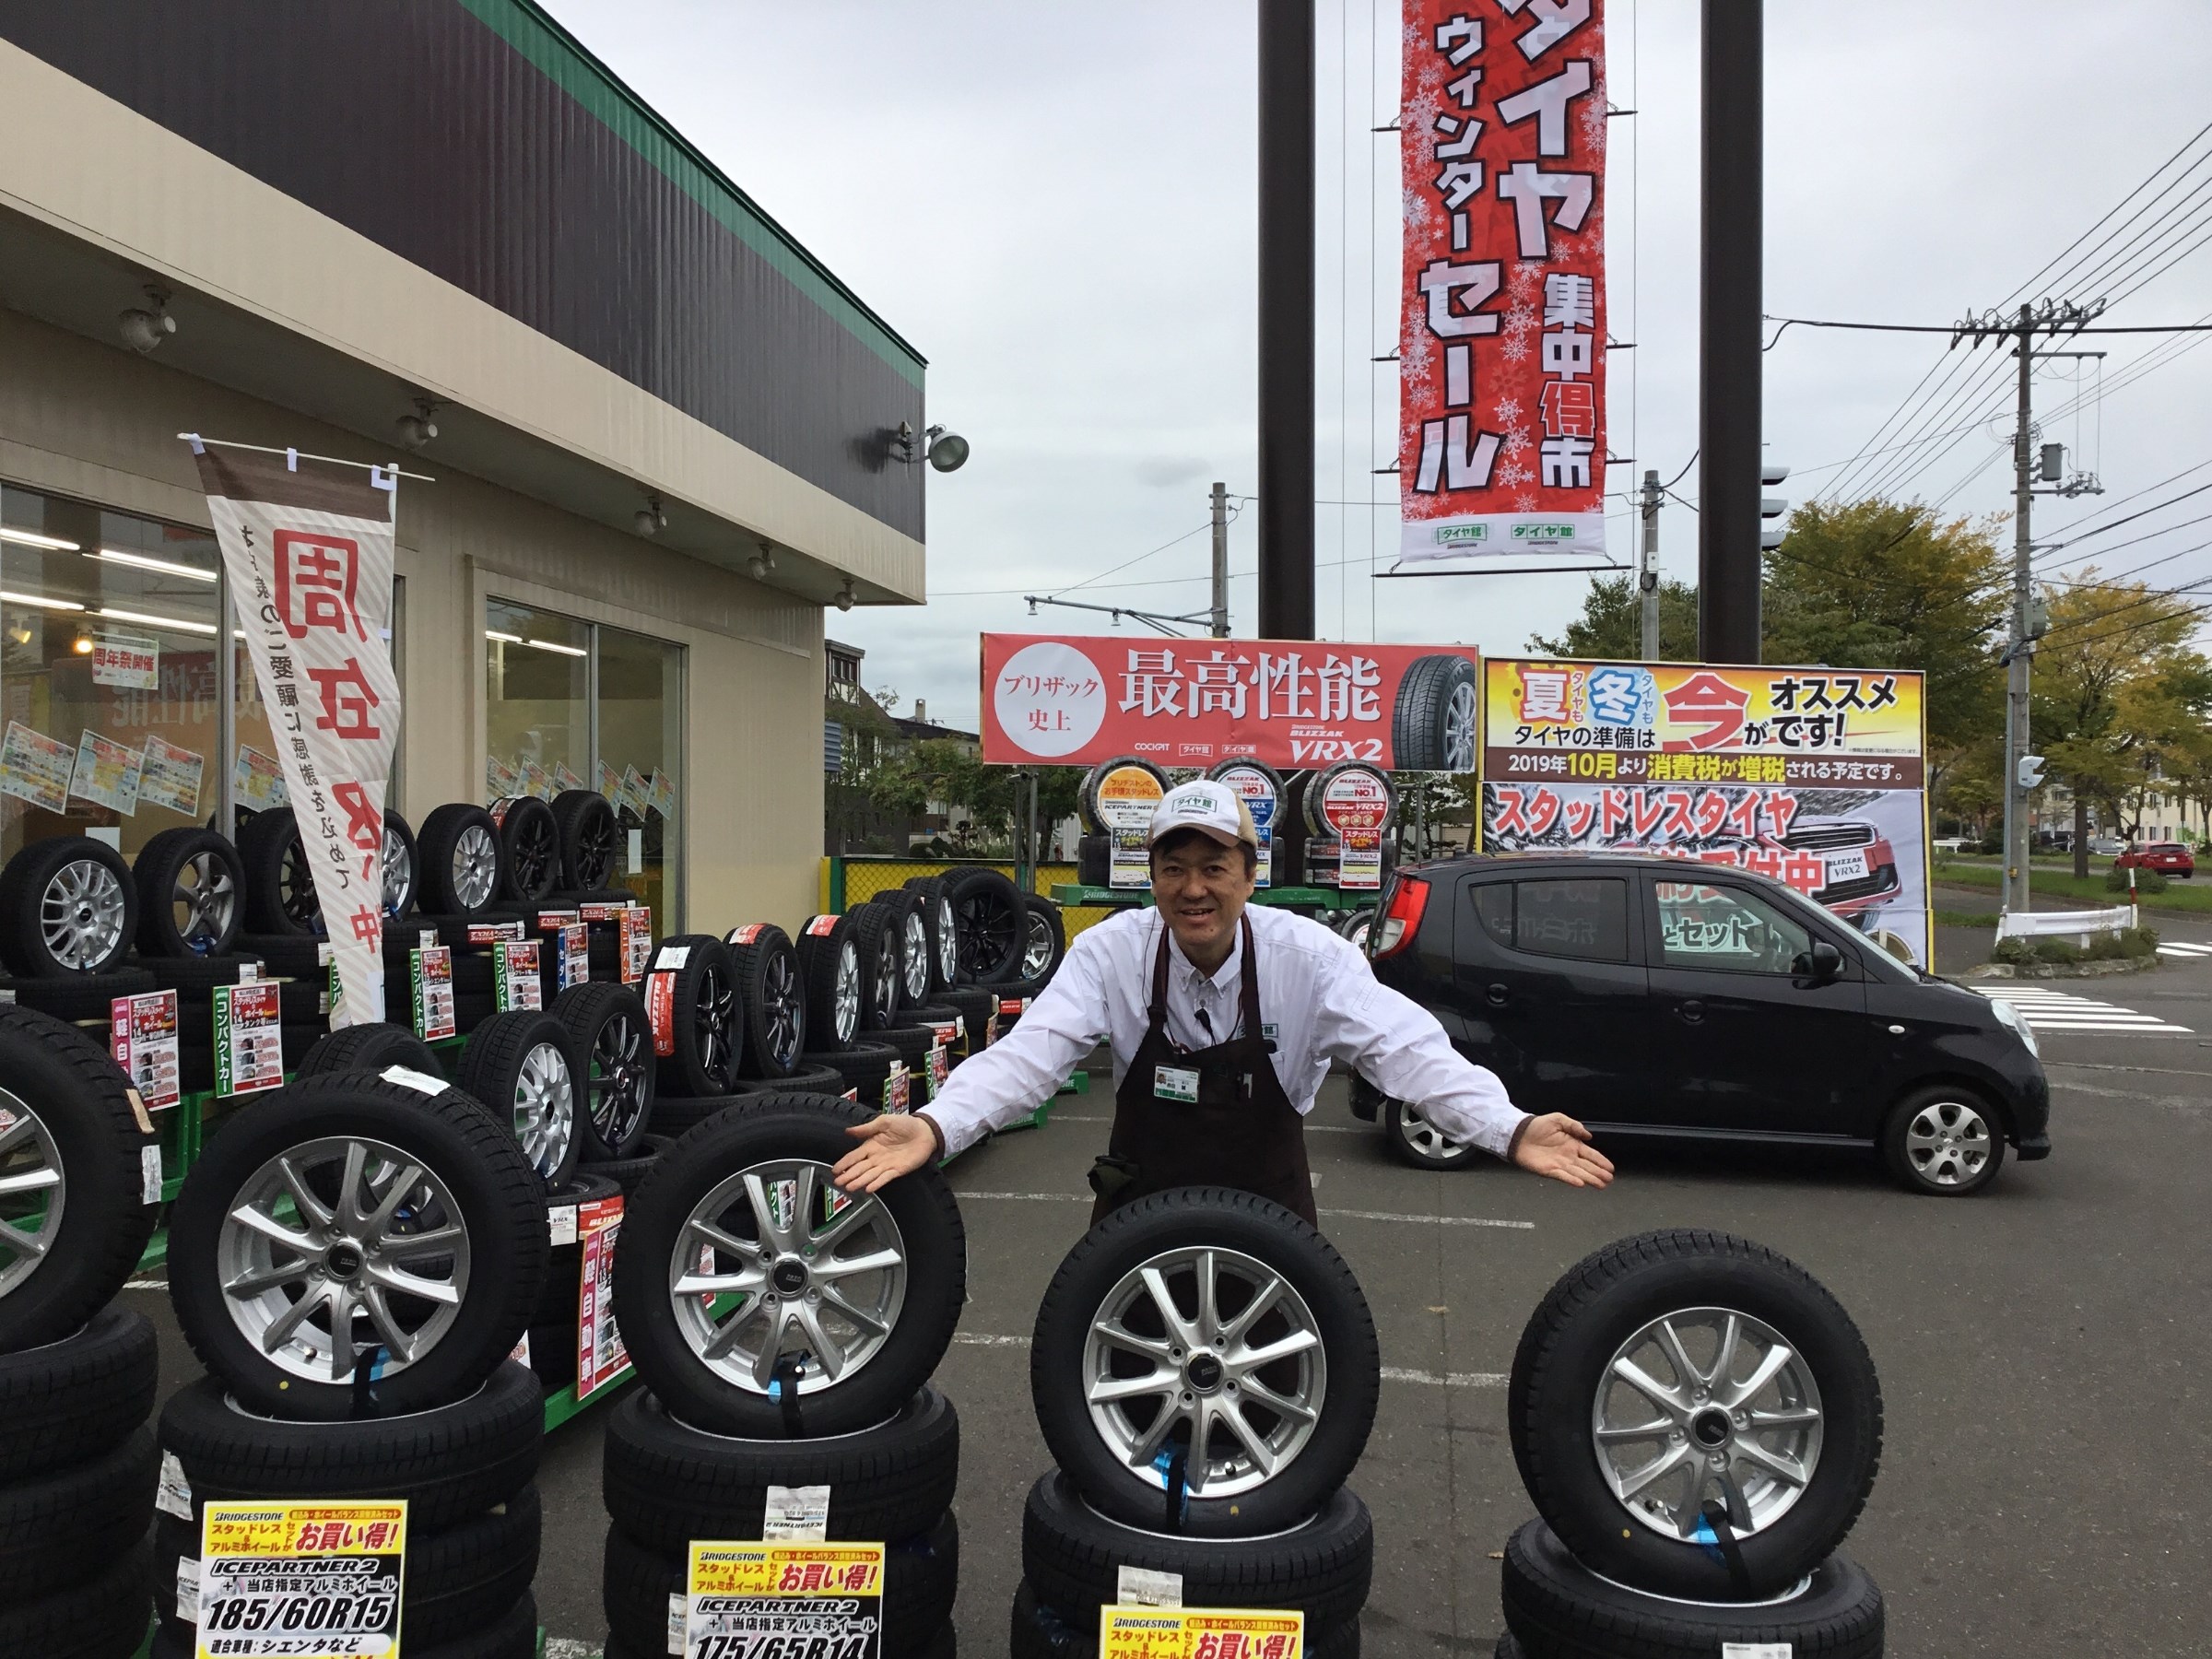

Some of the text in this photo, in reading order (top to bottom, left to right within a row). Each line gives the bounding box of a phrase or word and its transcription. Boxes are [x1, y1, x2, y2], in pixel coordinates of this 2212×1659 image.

[1442, 526, 1482, 539] タイヤ館
[1513, 526, 1573, 537] タイヤ館
[1004, 674, 1099, 698] ブリザック
[1117, 646, 1383, 723] 最高性能
[1520, 668, 1571, 724] 夏
[1572, 672, 1583, 722] タイヤも
[1589, 670, 1641, 725] 冬
[1641, 675, 1653, 724] タイヤも
[1771, 677, 1897, 710] オススメ
[1663, 674, 1749, 750] 今
[1029, 709, 1071, 732] 史上
[1514, 726, 1655, 748] タイヤの準備は
[1135, 743, 1170, 751] COCKPIT
[1182, 746, 1209, 754] タイヤ館
[1288, 739, 1383, 763] VRX2
[1355, 786, 1376, 797] NO.1
[1177, 797, 1212, 808] タイヤ館
[1495, 788, 1797, 838] スタッドレスタイヤ
[1828, 856, 1863, 867] BLIZZAK
[1834, 865, 1862, 877] VRX2
[621, 922, 629, 977] ミニバン
[412, 961, 424, 1038] コンパクトカー
[233, 1015, 242, 1024] 14
[244, 1009, 264, 1018] ホイール
[144, 1019, 162, 1030] ホイール
[133, 1028, 142, 1037] 14
[217, 1001, 229, 1093] コンパクトカー
[581, 1257, 597, 1382] 軽自動車
[215, 1512, 284, 1521] BRIDGESTONE
[211, 1524, 281, 1535] スタッドレス
[210, 1542, 281, 1553] アルミホイール
[700, 1551, 766, 1561] BRIDGESTONE
[698, 1563, 764, 1574] スタッドレス
[247, 1578, 395, 1593] 当店指定アルミホイール
[697, 1581, 764, 1592] アルミホイール
[207, 1595, 392, 1630] 185/60R15
[733, 1617, 876, 1631] 当店指定アルミホイール
[1113, 1618, 1182, 1629] BRIDGESTONE
[1111, 1630, 1179, 1642] スタッドレス
[696, 1635, 866, 1659] 175/65R14
[1110, 1649, 1179, 1659] アルミホイール
